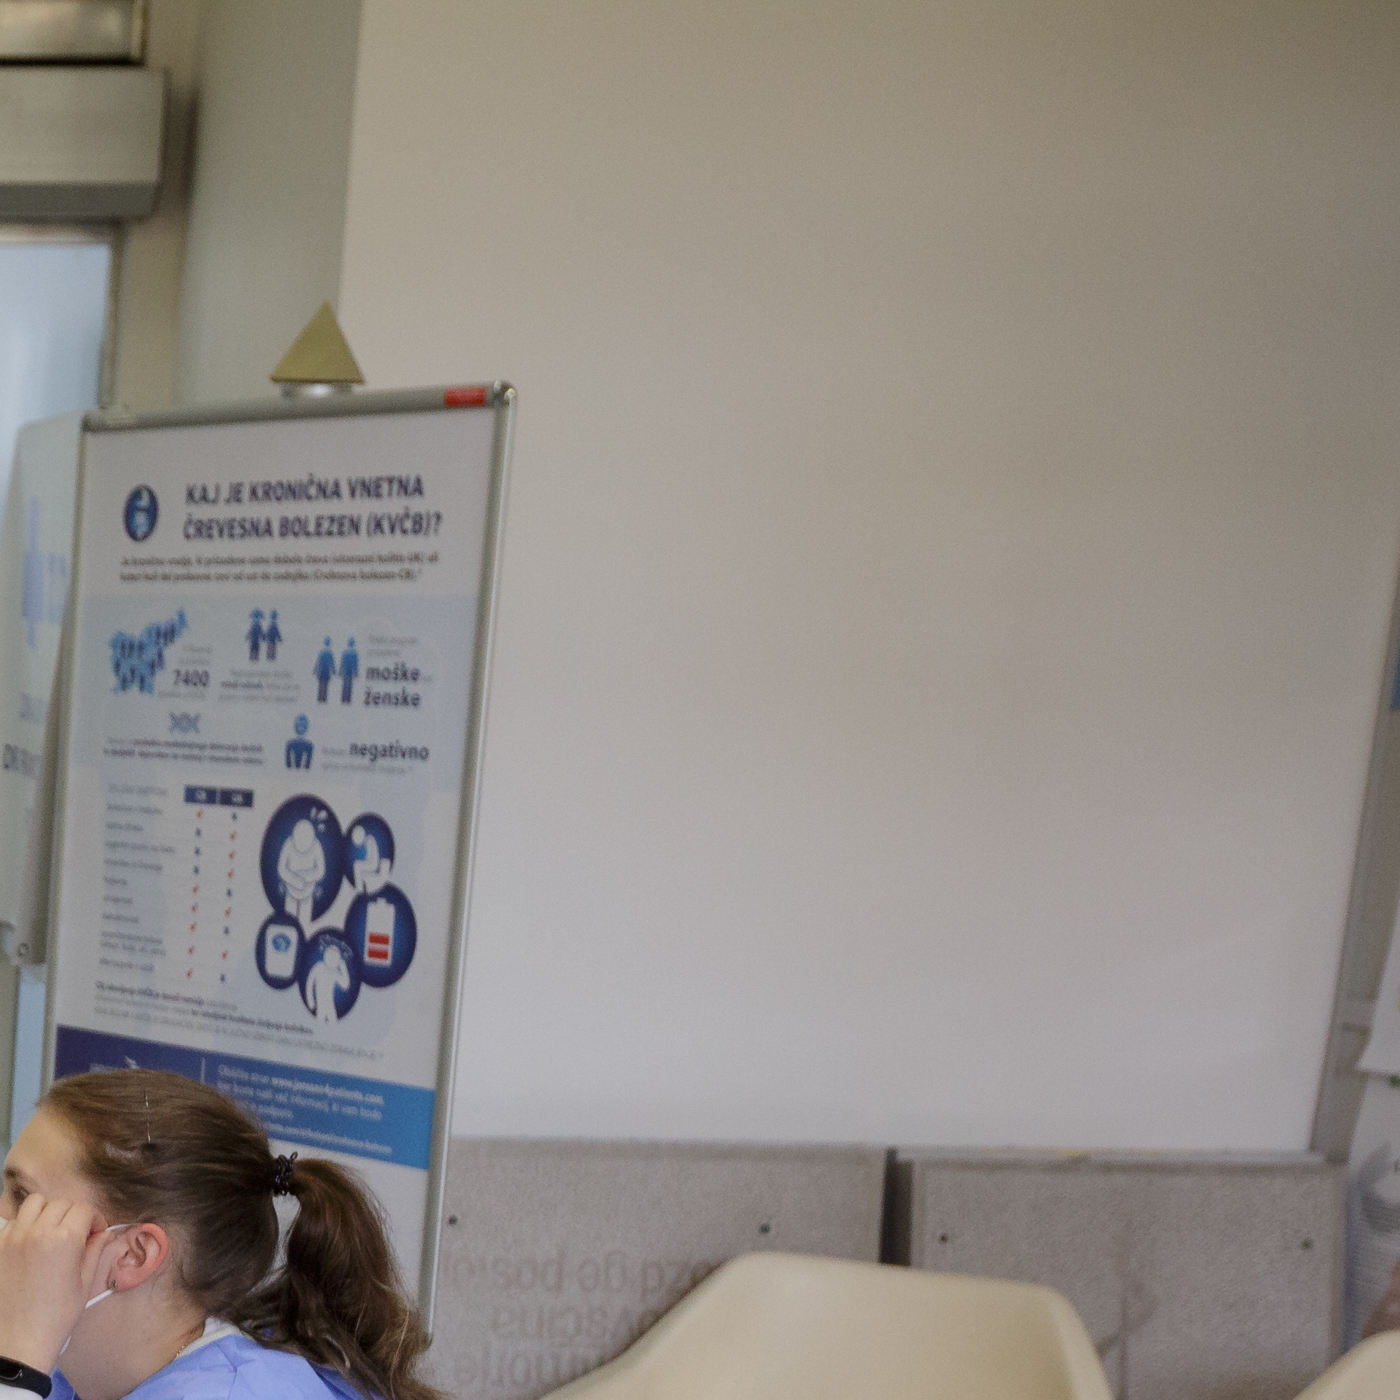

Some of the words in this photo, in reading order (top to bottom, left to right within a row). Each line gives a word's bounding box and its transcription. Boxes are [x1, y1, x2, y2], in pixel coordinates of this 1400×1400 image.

[185, 483, 220, 505] KAJ
[223, 482, 245, 503] JE
[249, 473, 342, 503] KRONIČNA
[348, 474, 425, 500] VNETNA
[183, 512, 273, 541] ČREVESNA
[278, 511, 361, 539] BOLEZEN
[366, 505, 443, 537] (KVČB)?
[172, 668, 211, 689] 7400
[366, 661, 422, 683] moške
[363, 687, 422, 709] ženske
[349, 738, 430, 763] negativno
